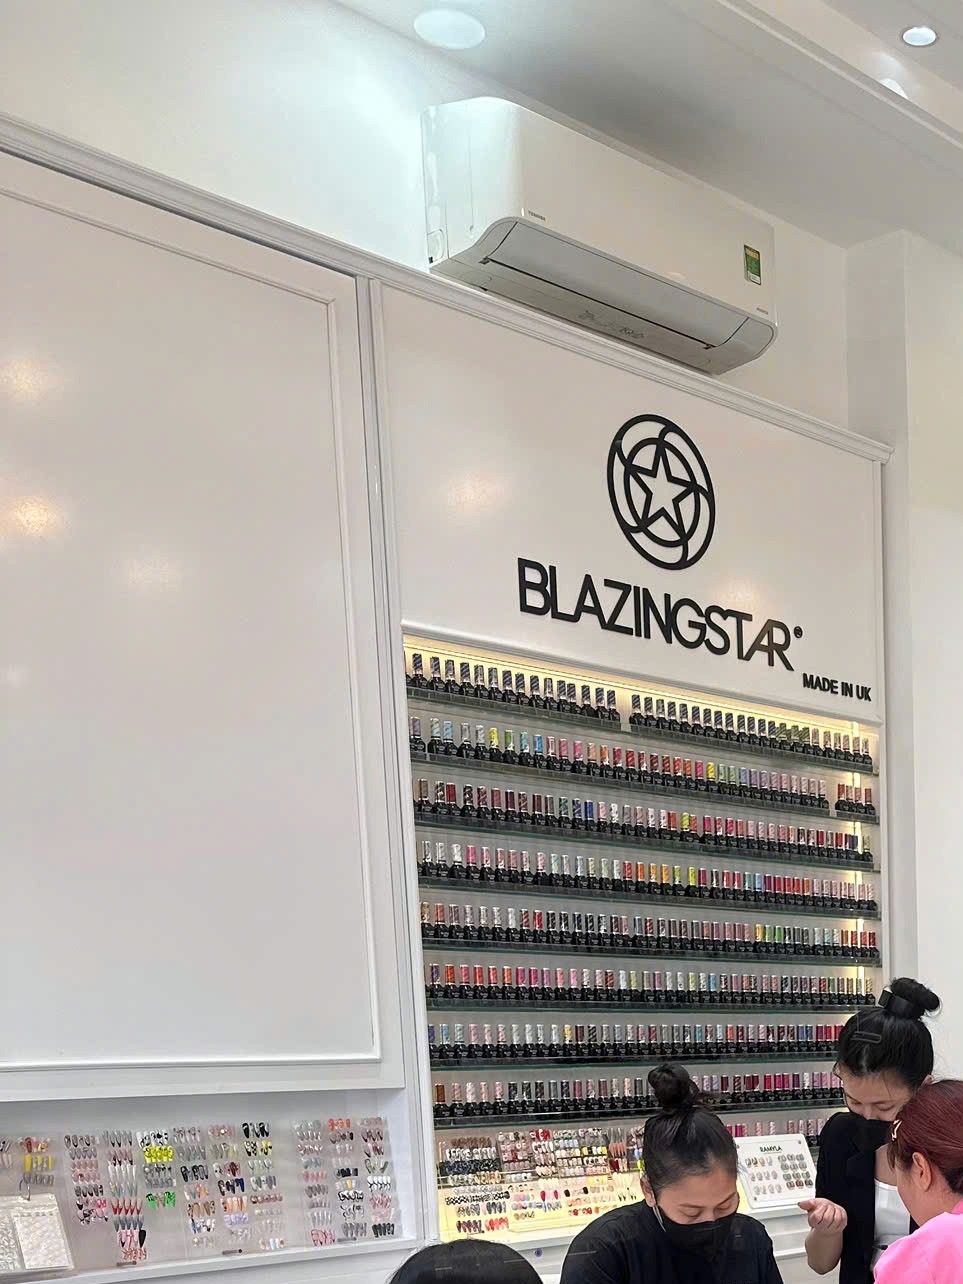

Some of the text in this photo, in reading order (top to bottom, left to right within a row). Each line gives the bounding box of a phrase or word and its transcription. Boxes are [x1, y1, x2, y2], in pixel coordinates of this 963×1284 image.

[802, 672, 872, 702] MADE IN UK
